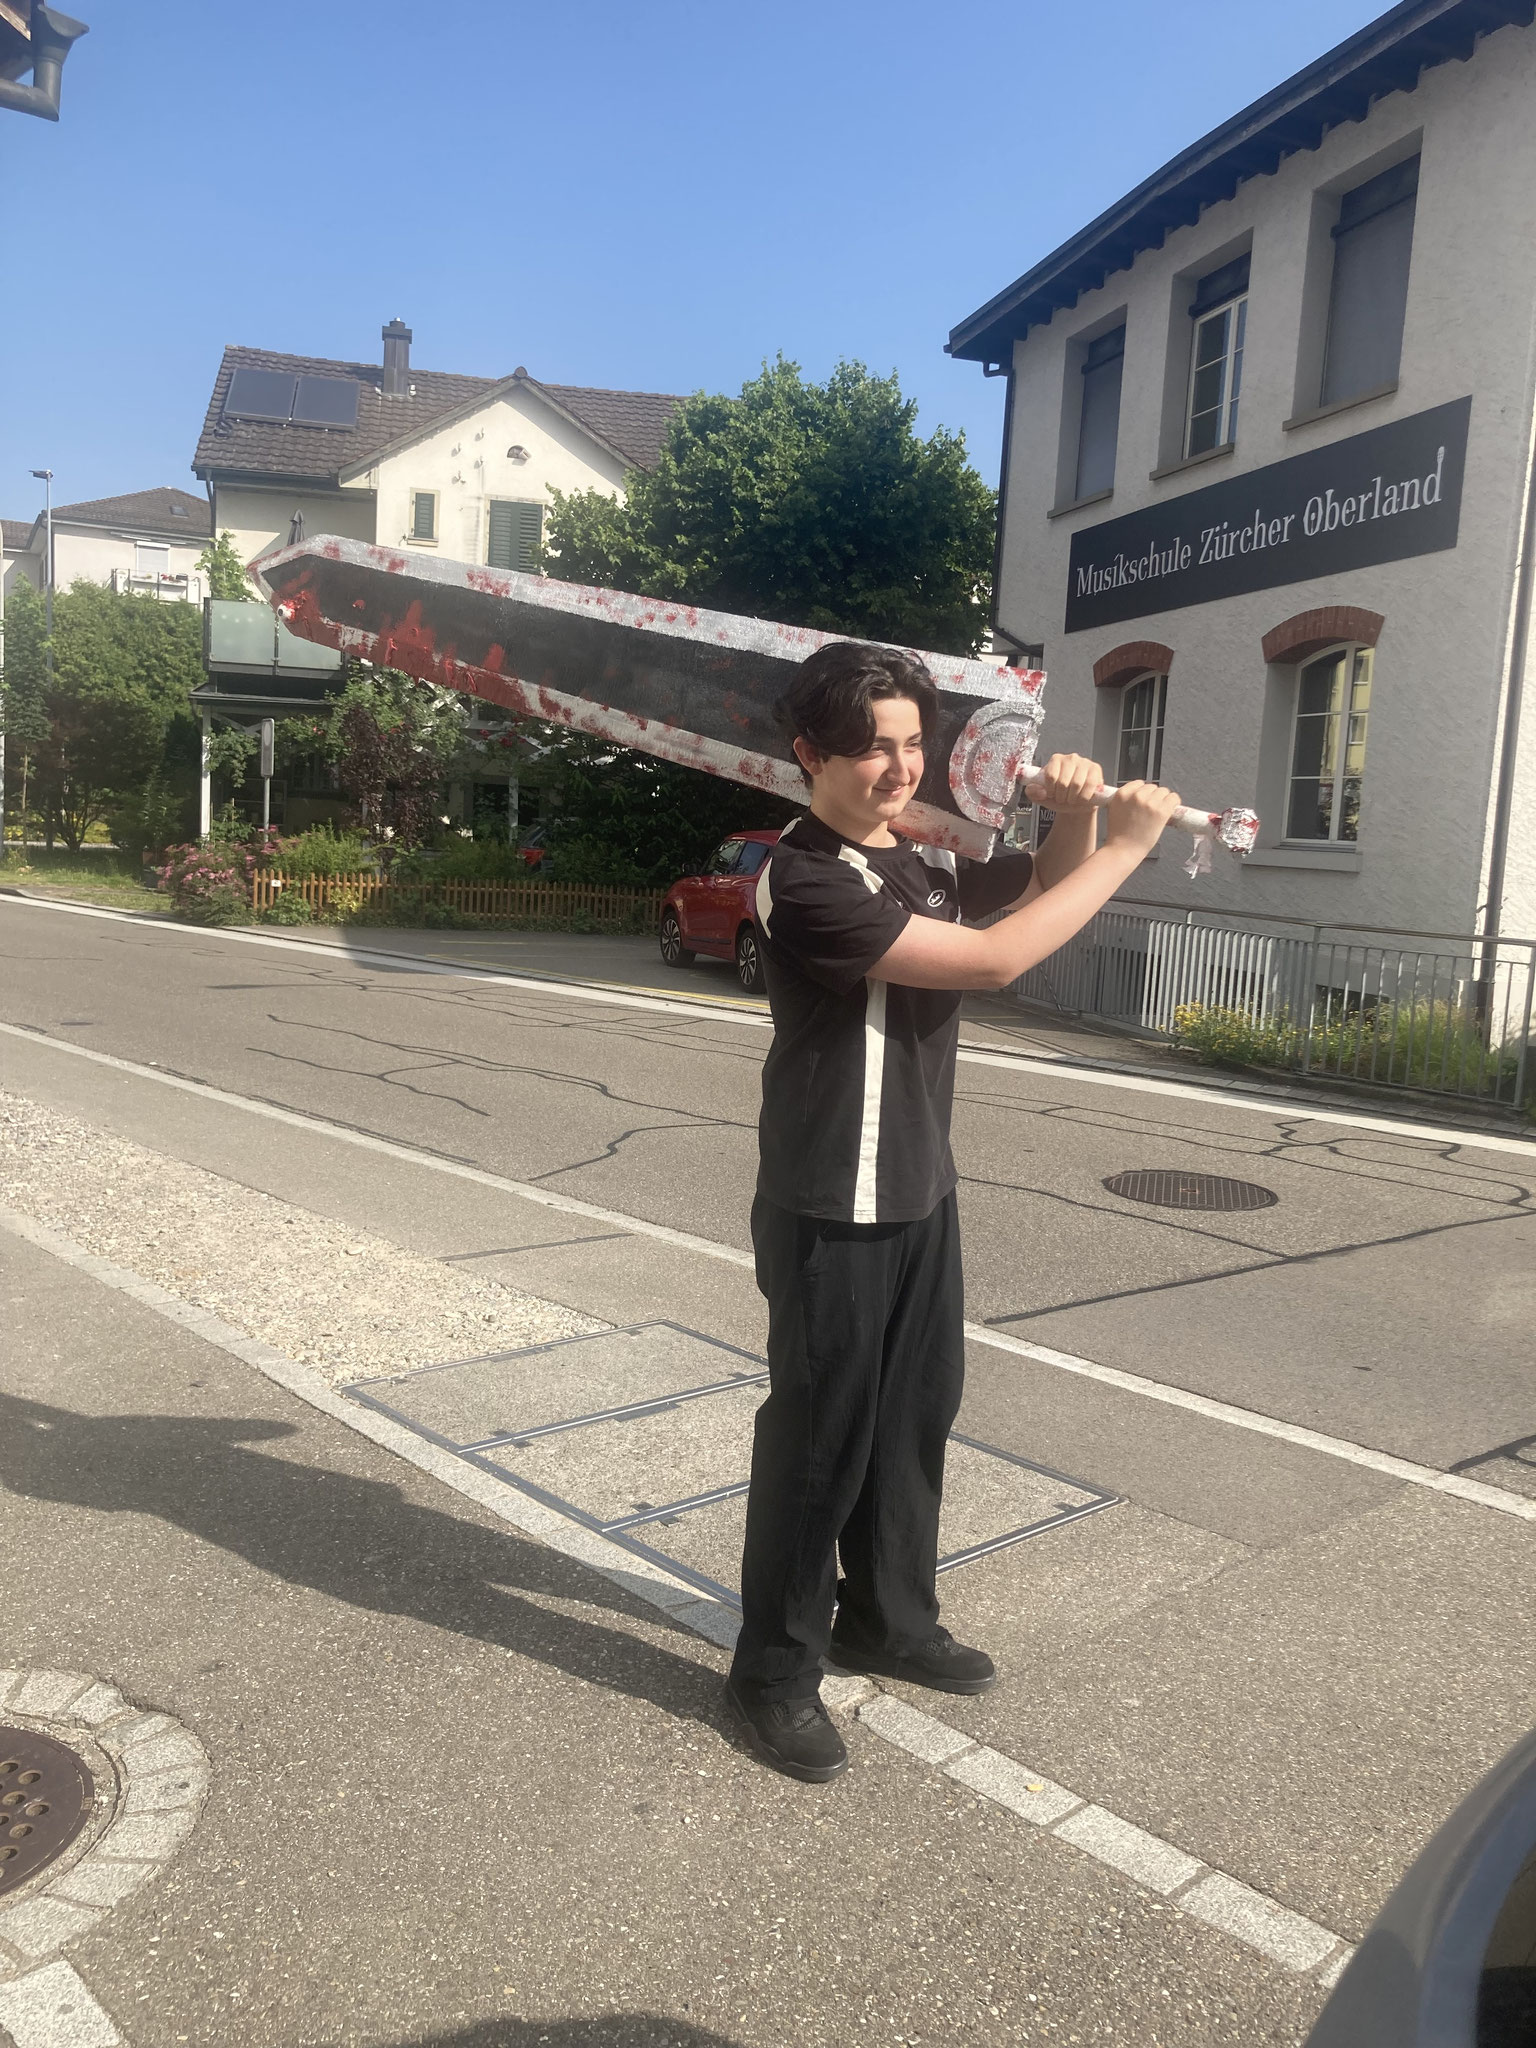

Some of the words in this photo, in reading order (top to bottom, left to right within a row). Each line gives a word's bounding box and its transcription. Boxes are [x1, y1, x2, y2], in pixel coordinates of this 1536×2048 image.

[1076, 537, 1192, 598] Musikschule
[1198, 508, 1295, 565] Zürcher
[1302, 445, 1445, 536] Oberland
